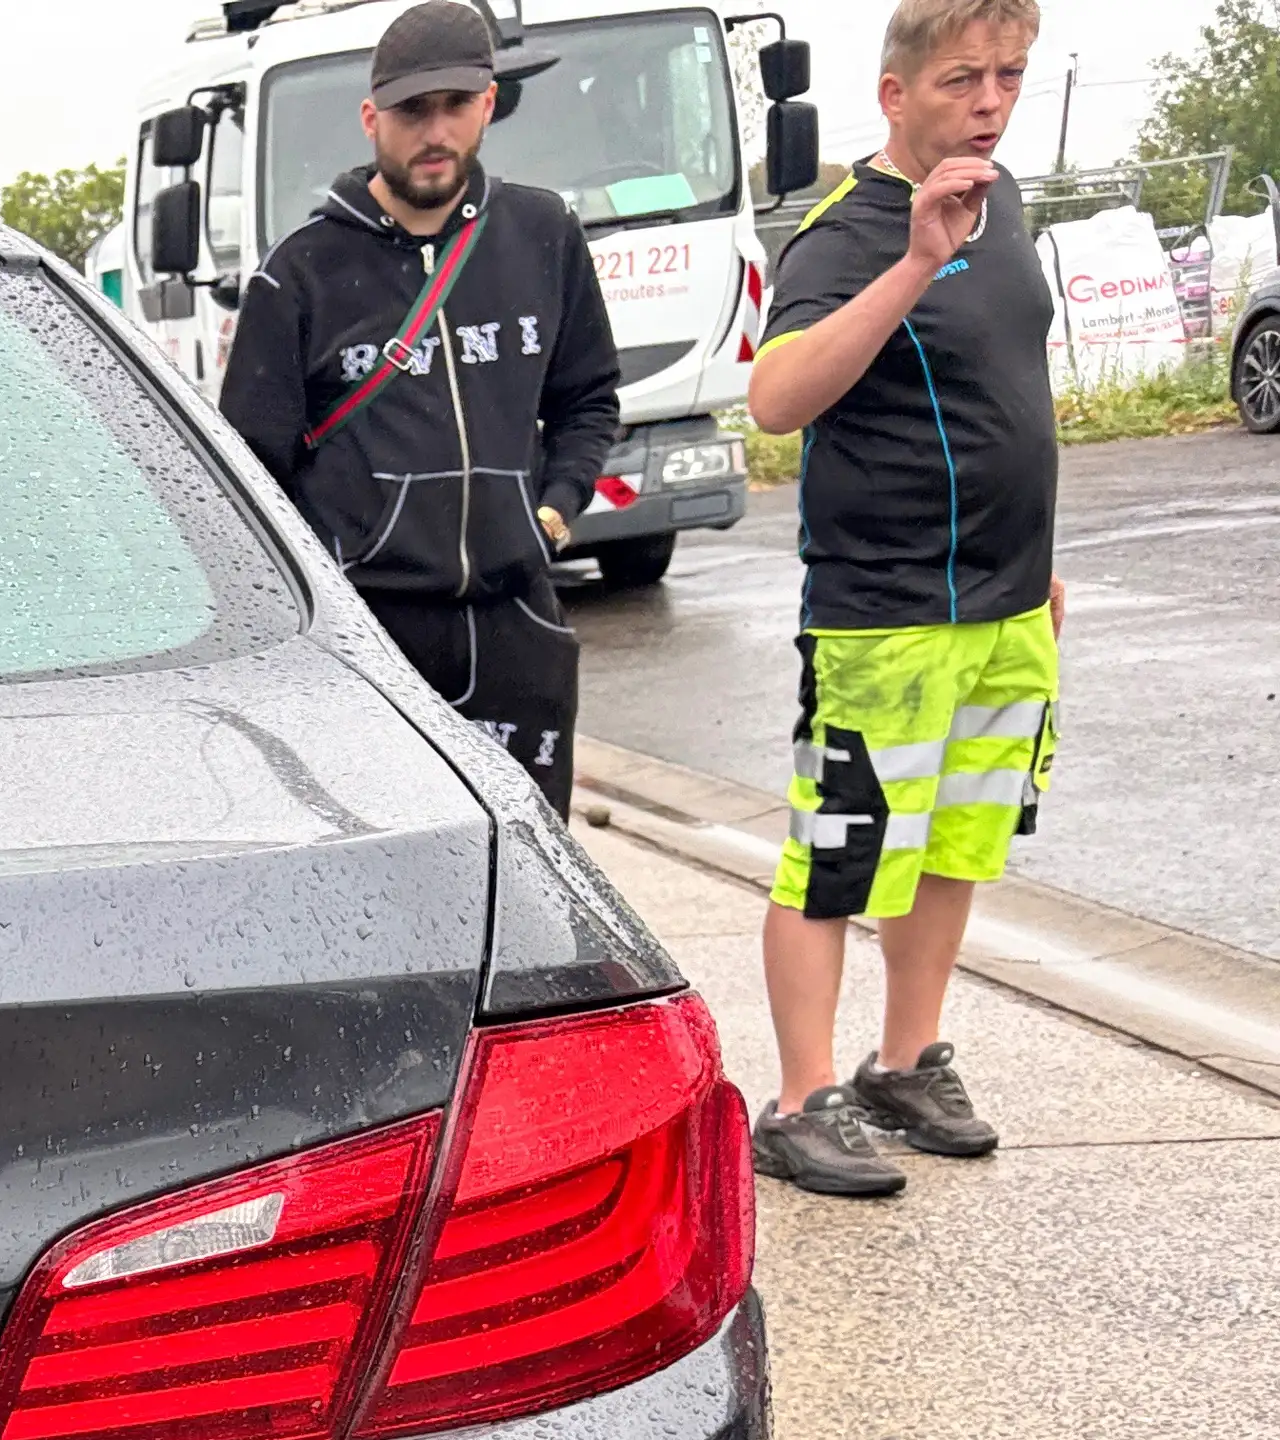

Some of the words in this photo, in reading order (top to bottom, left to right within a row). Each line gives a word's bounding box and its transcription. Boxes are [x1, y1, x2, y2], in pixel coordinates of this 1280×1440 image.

[593, 250, 634, 280] 221
[647, 244, 690, 274] 221
[1082, 312, 1134, 328] Lambert
